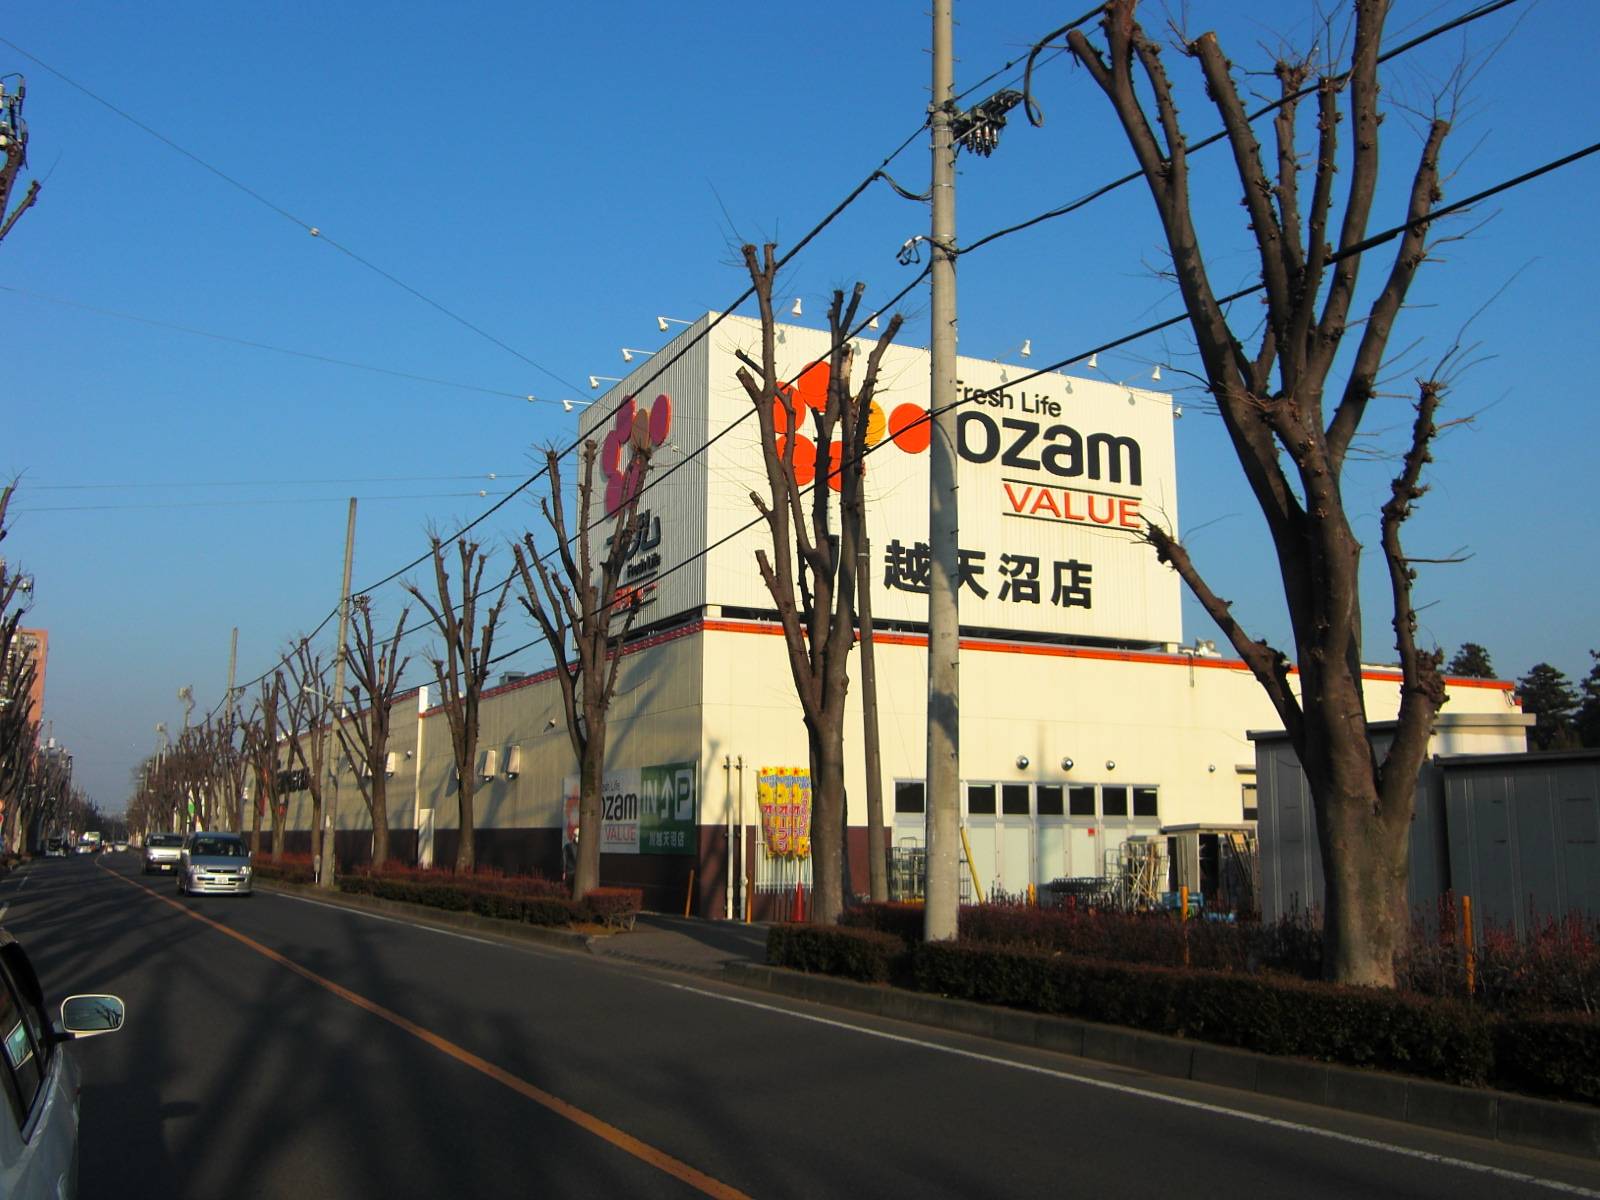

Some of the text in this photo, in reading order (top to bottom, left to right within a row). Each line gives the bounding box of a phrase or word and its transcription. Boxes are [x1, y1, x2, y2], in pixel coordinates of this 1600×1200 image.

[1020, 391, 1061, 418] Life
[1003, 483, 1143, 529] VALUE
[642, 779, 658, 814] IN
[604, 824, 637, 842] VALUE
